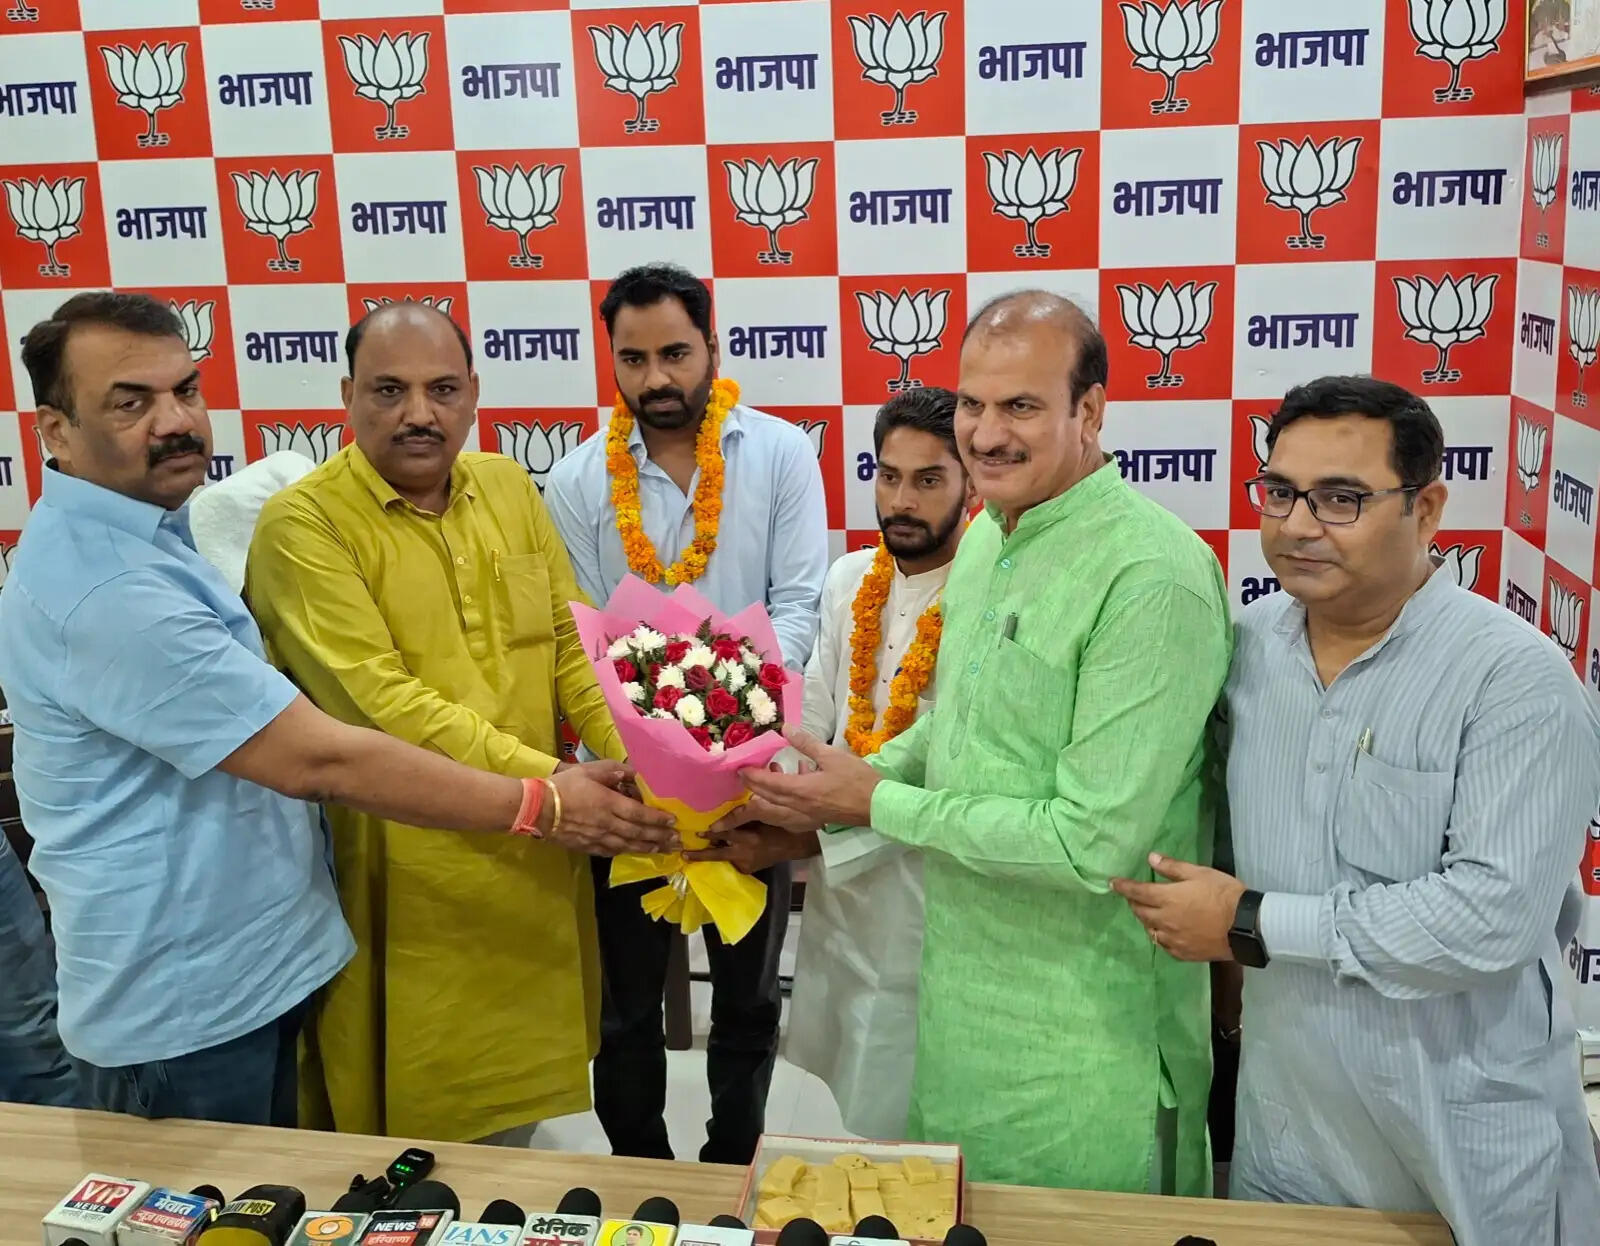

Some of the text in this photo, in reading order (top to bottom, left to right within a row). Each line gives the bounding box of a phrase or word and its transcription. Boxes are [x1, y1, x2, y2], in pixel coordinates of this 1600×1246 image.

[979, 42, 1086, 81] भाजपा
[1256, 29, 1369, 68] भाजपा
[219, 72, 312, 106] भाजपा
[463, 64, 560, 98] भाजपा
[716, 54, 818, 91] भाजपा
[1114, 179, 1222, 216] भाजपा
[1393, 169, 1507, 206] भाजपा
[1572, 170, 1600, 211] भाज
[117, 207, 207, 240] भाजपा
[352, 201, 446, 234] भाजपा
[598, 196, 695, 230] भाजपा
[850, 189, 953, 225] भाजपा
[246, 332, 338, 362] भाजपा
[485, 329, 580, 361] भाजपा
[730, 326, 827, 359] भाजपा
[1248, 314, 1357, 348] भाजपा
[1521, 312, 1556, 356] भाजपा
[1554, 469, 1593, 525] भाजपा
[74, 1202, 106, 1213] NEWS
[81, 1181, 130, 1205] VIP
[154, 1195, 196, 1216] मेवात
[245, 1202, 272, 1214] POST
[374, 1217, 433, 1232] NEWS 18
[445, 1226, 514, 1245] IANS
